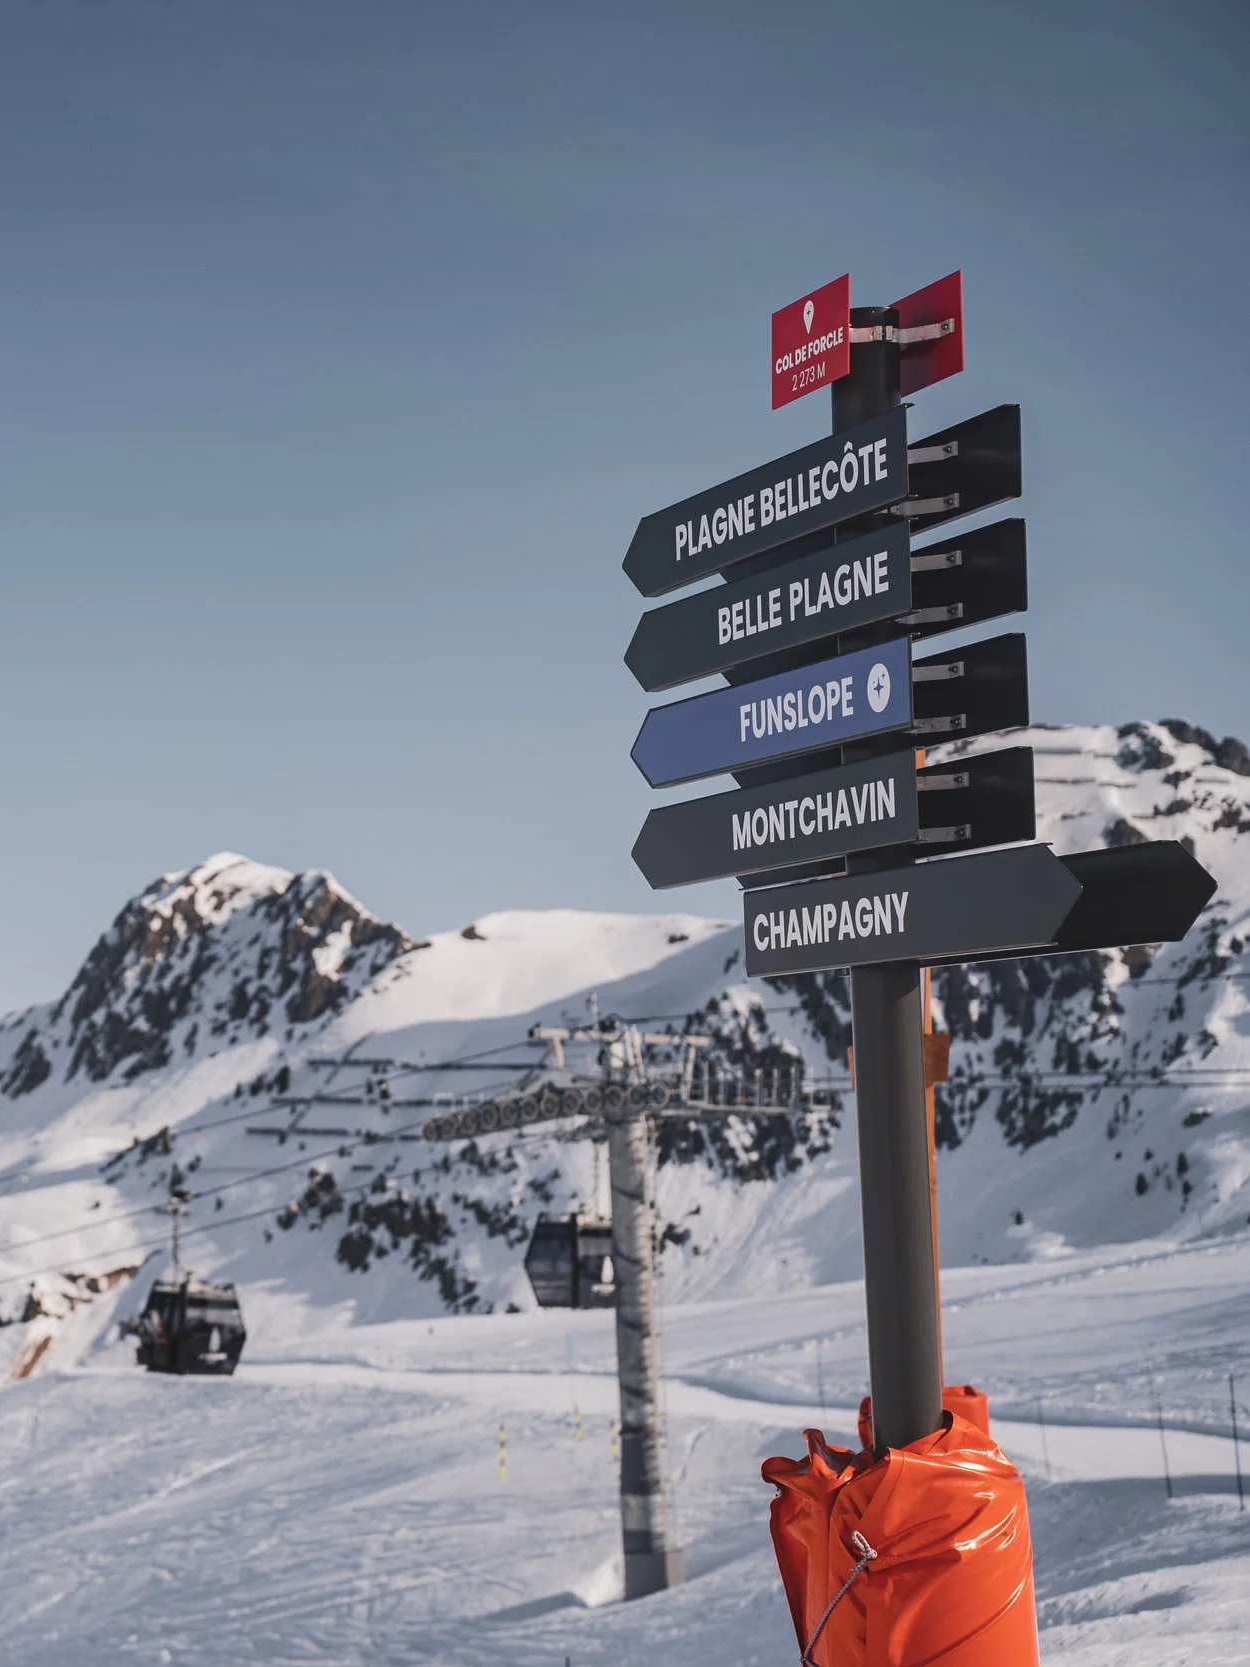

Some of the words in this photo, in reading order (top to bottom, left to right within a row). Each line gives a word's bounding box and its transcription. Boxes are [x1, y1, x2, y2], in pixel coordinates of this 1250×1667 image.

[775, 353, 793, 374] COL
[795, 345, 807, 365] DE
[808, 326, 844, 359] FORCLE
[817, 361, 826, 380] M
[675, 494, 754, 561] PLAGNE
[760, 438, 888, 527] BELLECÔTE
[718, 588, 781, 645] BELLE
[790, 550, 889, 621] PLAGNE
[740, 676, 854, 742] FUNSLOPE
[732, 778, 896, 851] MONTCHAVIN
[753, 891, 909, 952] CHAMPAGNY
